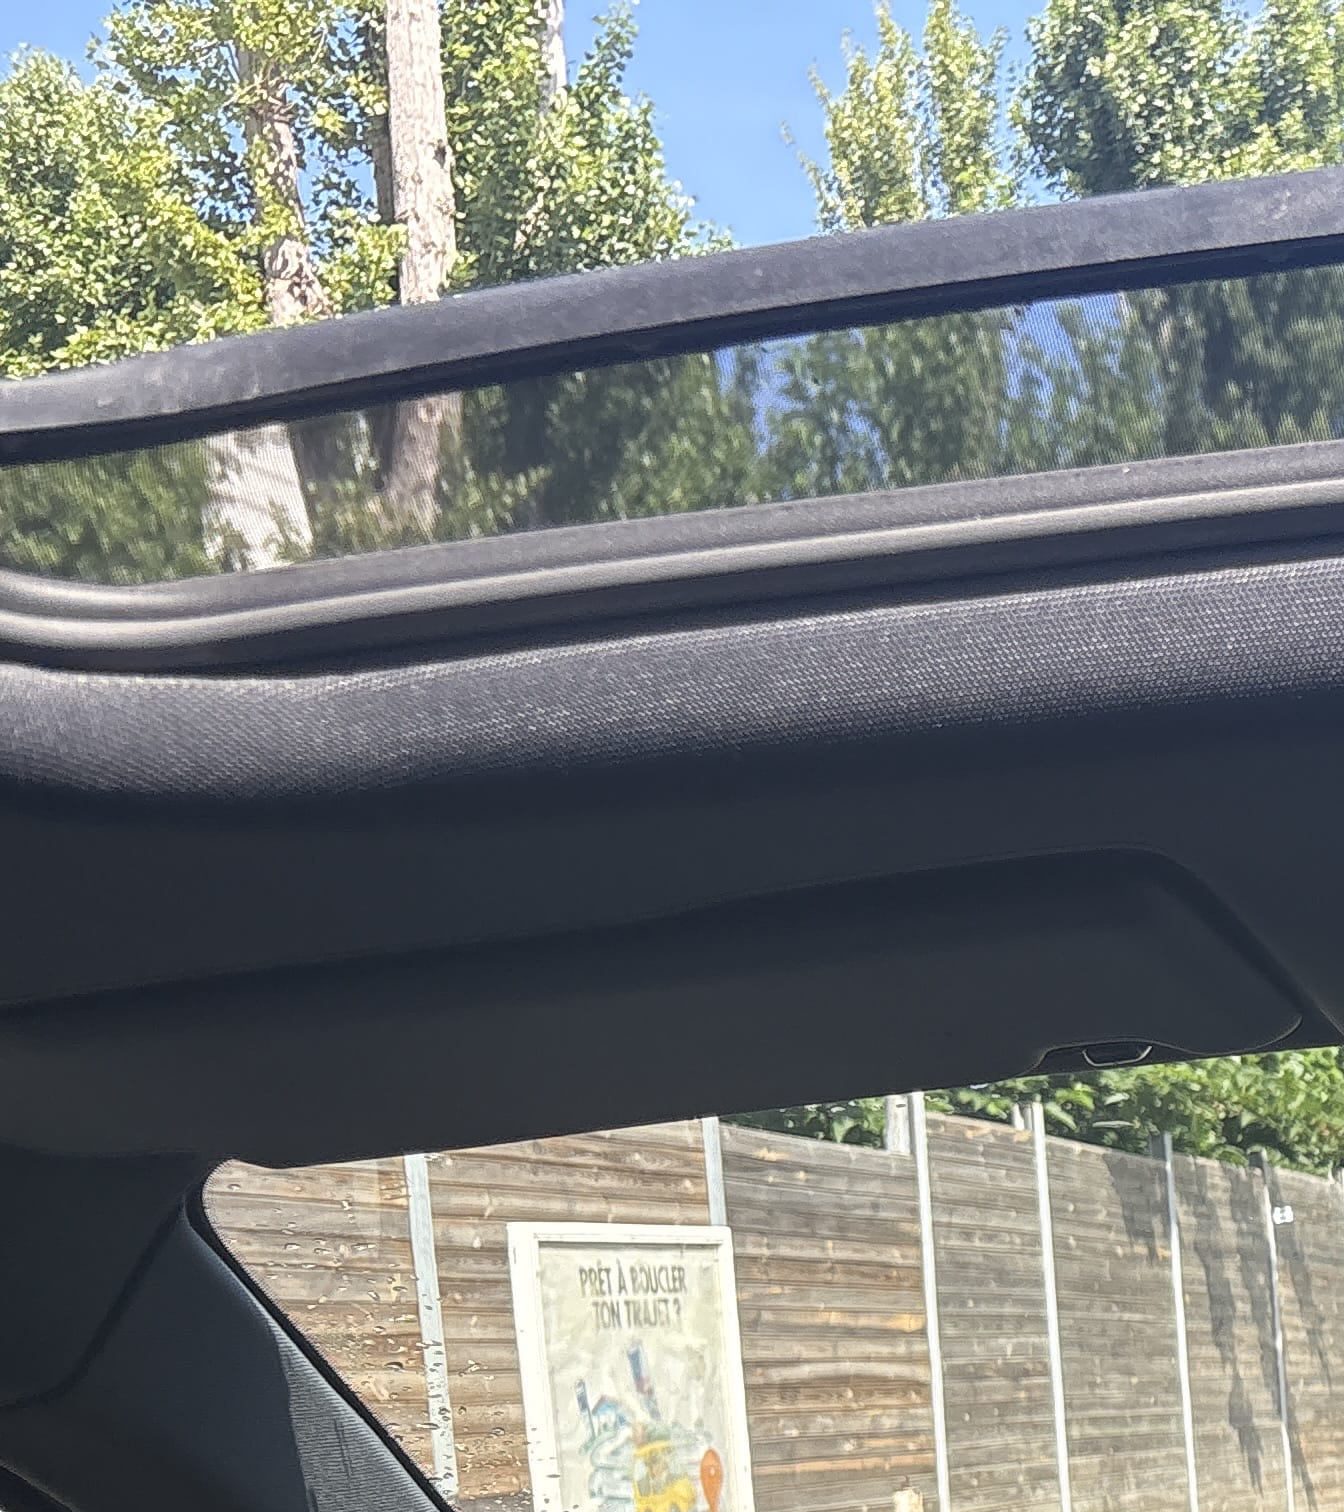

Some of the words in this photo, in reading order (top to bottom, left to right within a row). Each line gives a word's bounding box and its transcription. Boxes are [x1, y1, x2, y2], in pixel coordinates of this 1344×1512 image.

[629, 1264, 688, 1294] BOUCLER
[591, 1299, 621, 1330] TON
[624, 1299, 670, 1329] TRAJET
